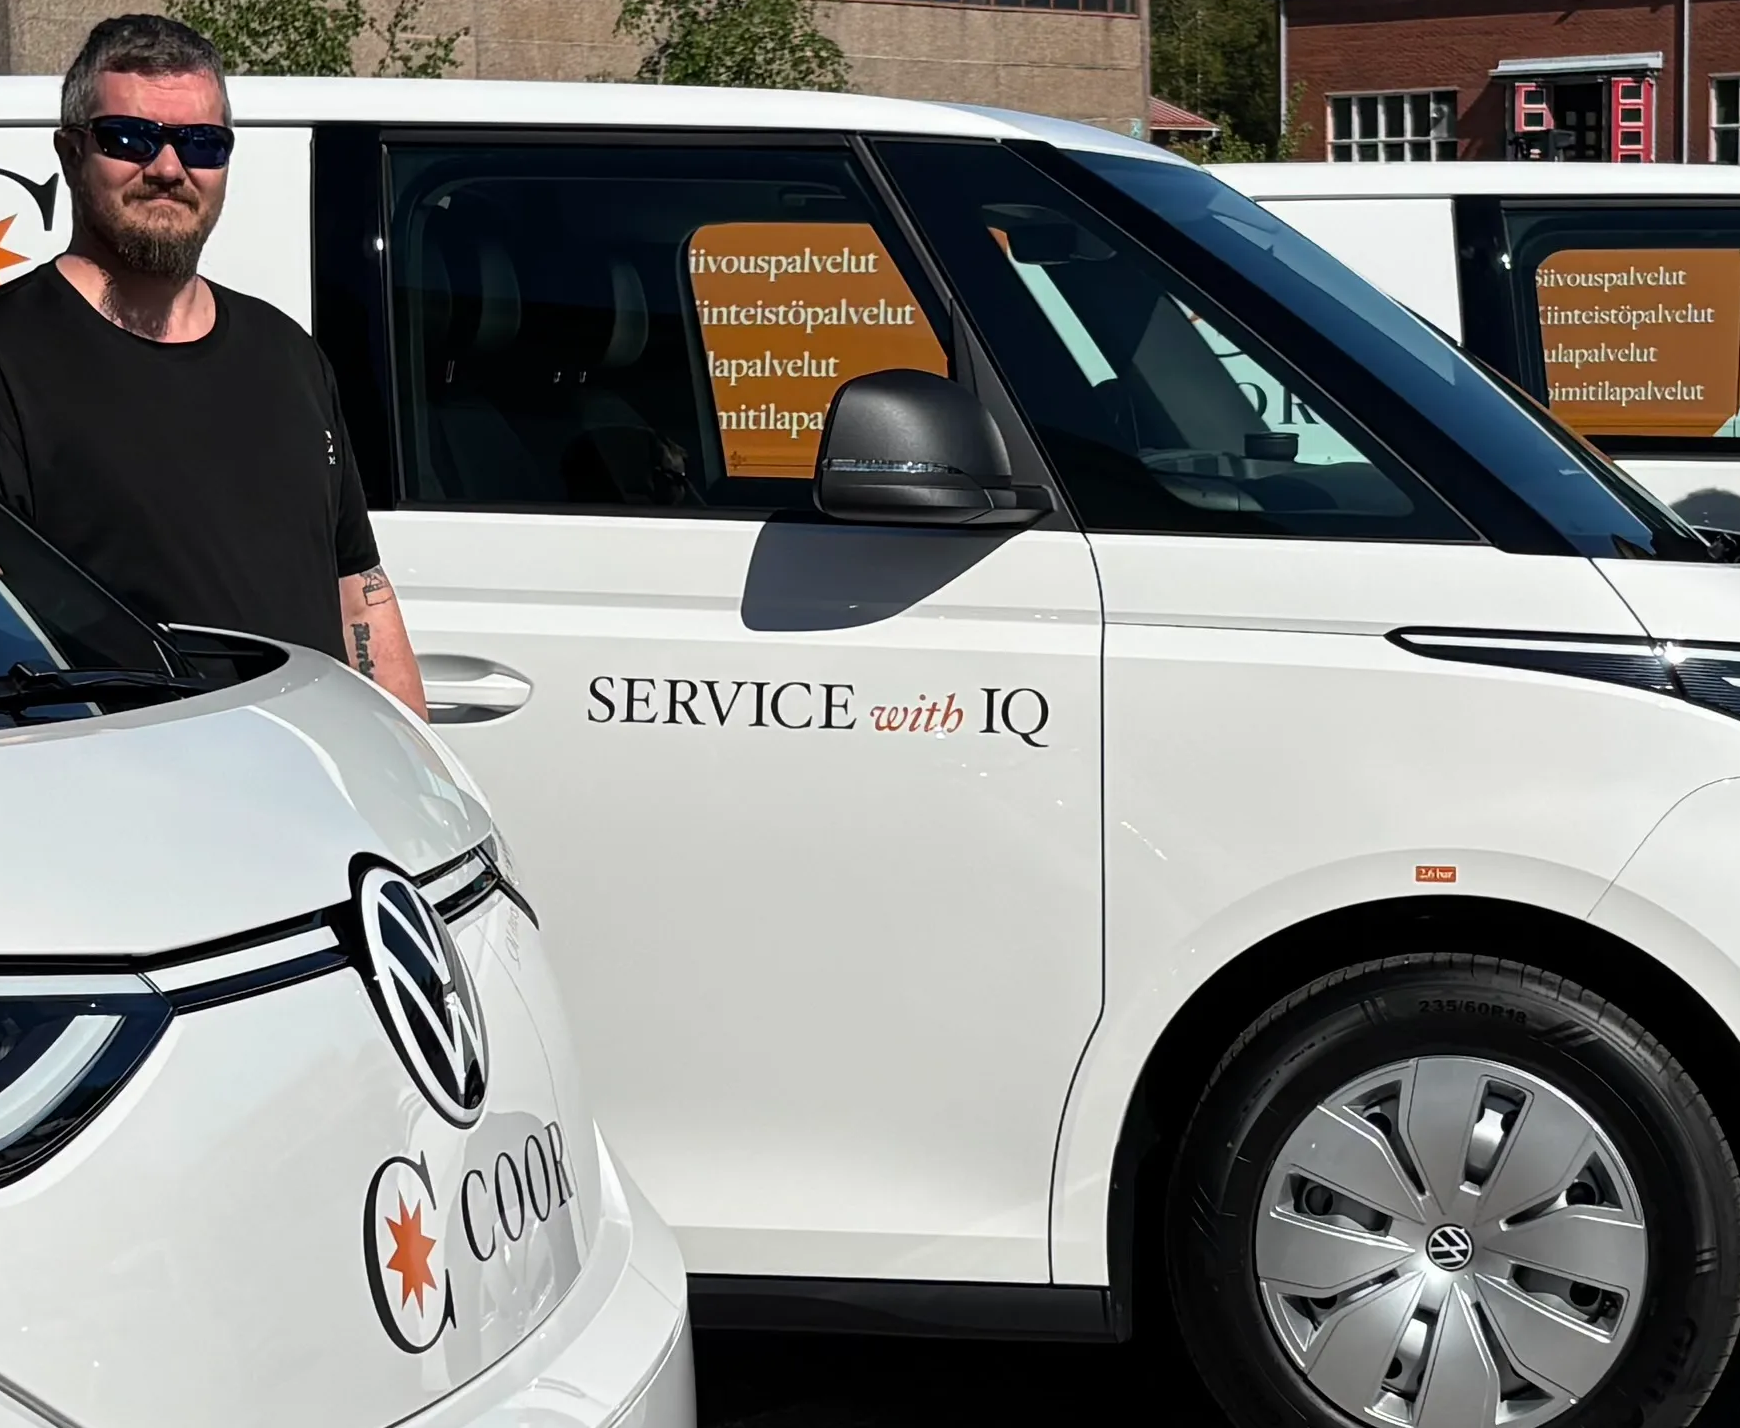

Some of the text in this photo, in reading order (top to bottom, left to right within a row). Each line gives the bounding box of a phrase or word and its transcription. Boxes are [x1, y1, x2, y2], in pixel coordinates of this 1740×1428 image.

[689, 247, 879, 283] iivouspalvelut
[706, 350, 840, 387] lapalvelut
[1544, 342, 1659, 370] ulapalvelut
[718, 403, 831, 439] mitilapa
[587, 675, 1051, 748] SERVICE with IQ
[460, 1119, 572, 1264] COOR
